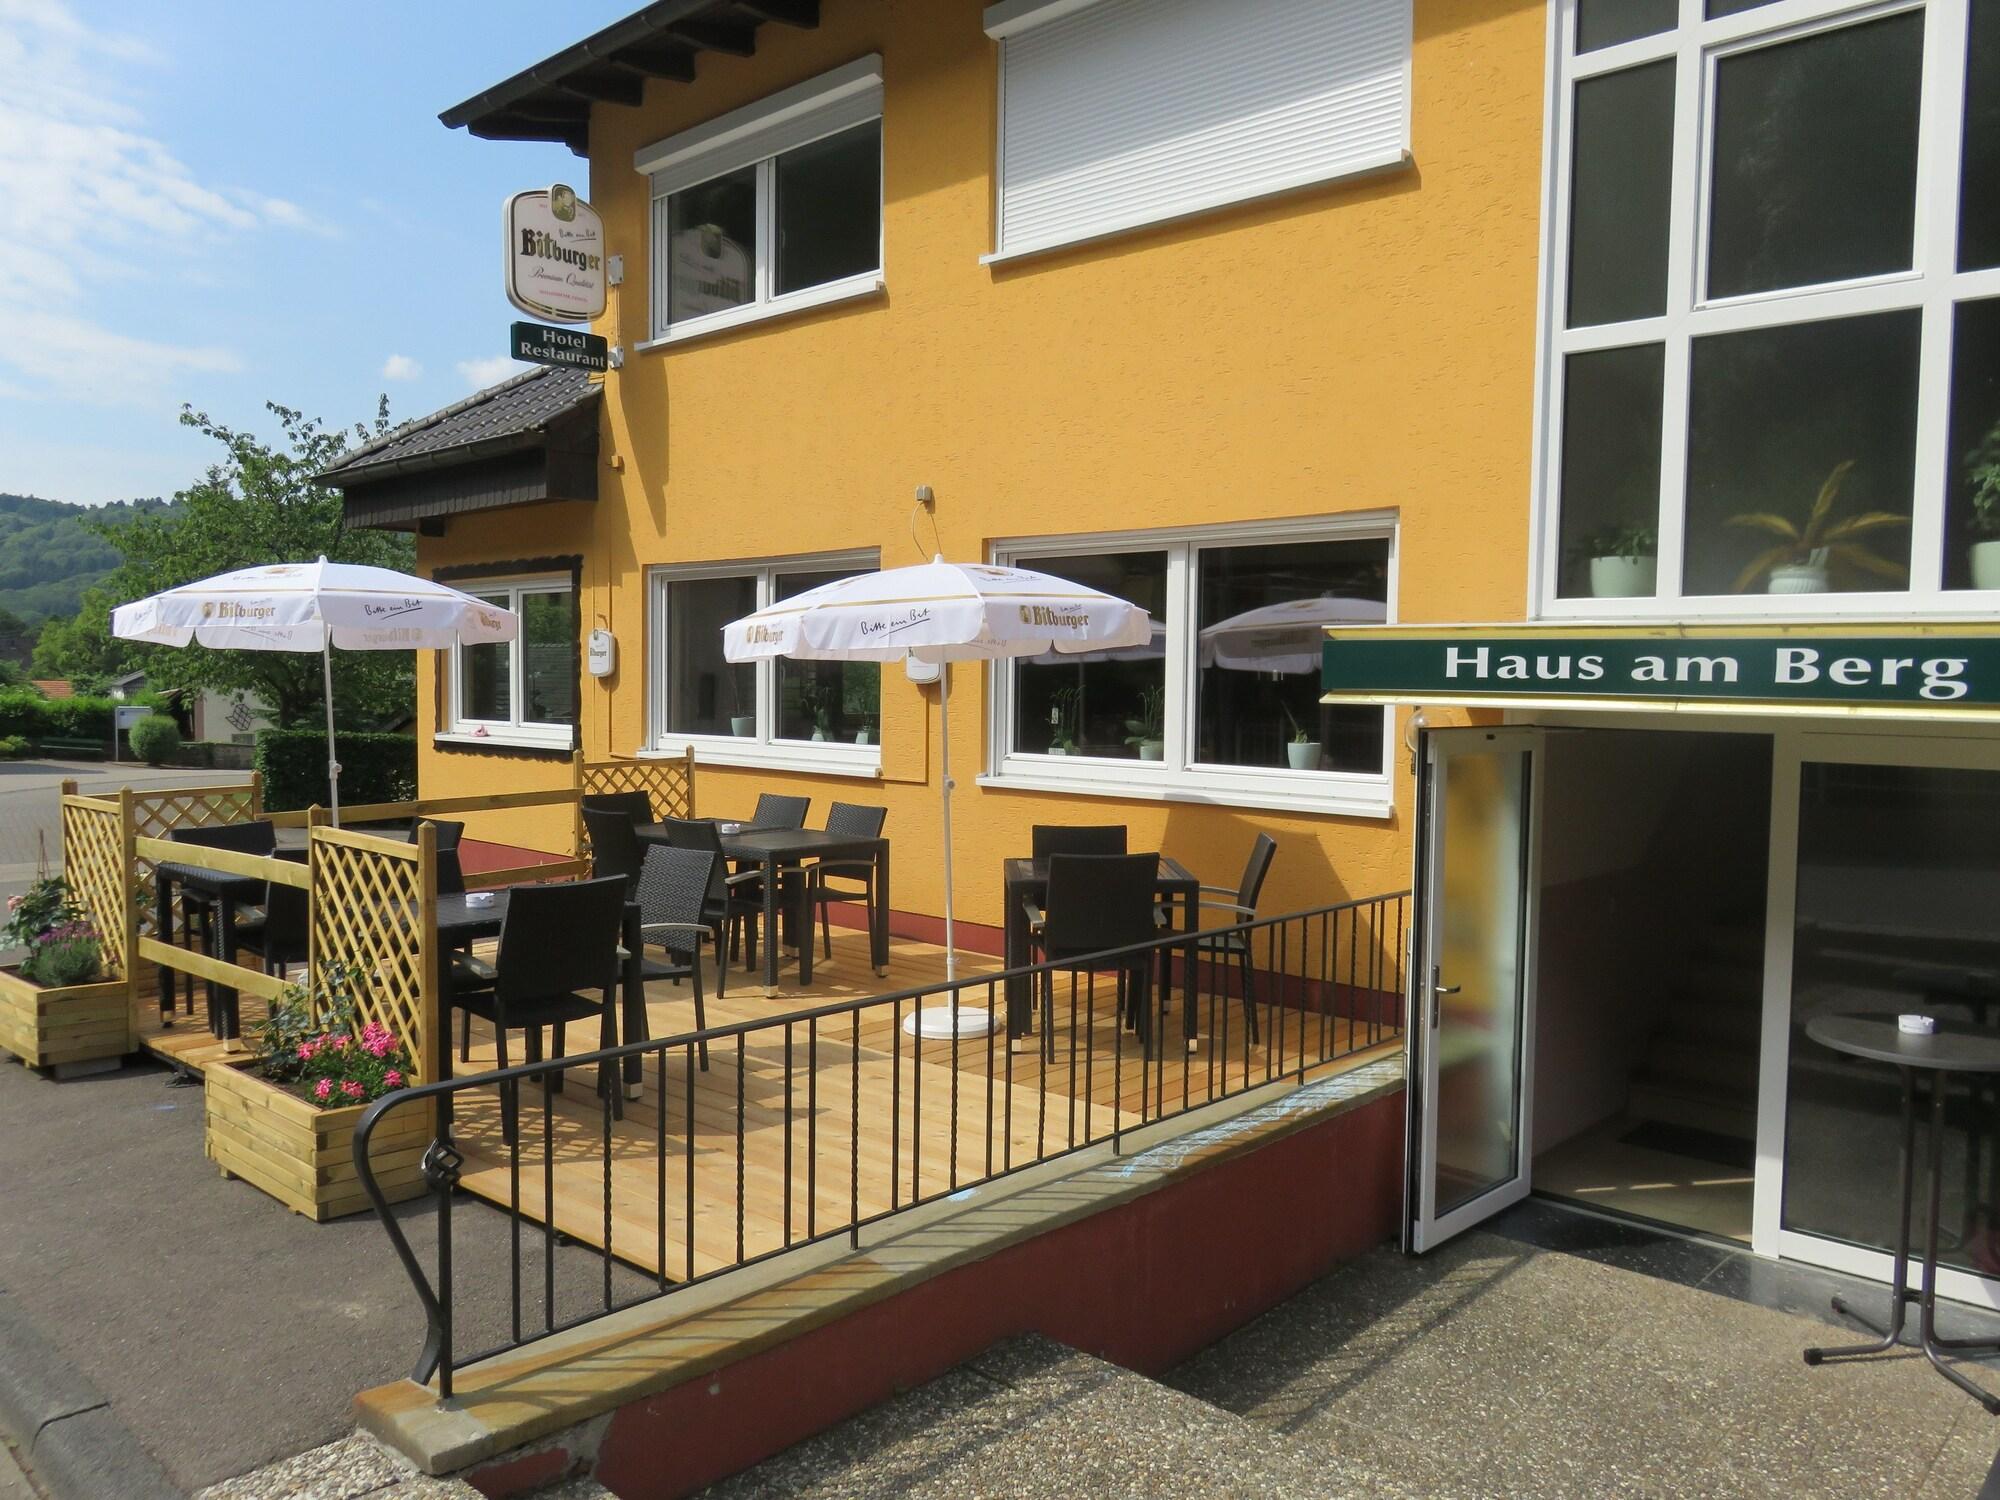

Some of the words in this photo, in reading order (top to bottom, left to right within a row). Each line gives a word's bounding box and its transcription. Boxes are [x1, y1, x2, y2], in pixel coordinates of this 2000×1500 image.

[521, 228, 600, 271] Bitburger
[543, 330, 586, 348] Hotel
[521, 342, 605, 368] Restaurant
[218, 602, 276, 618] Bitburger
[364, 604, 386, 616] Bitte
[860, 621, 886, 636] Bitte
[890, 616, 906, 628] ein
[910, 608, 930, 621] Bit
[1033, 606, 1089, 629] Bitburger
[1445, 646, 1605, 680] Haus
[1631, 650, 1740, 683] am
[1775, 647, 1970, 700] Berg
